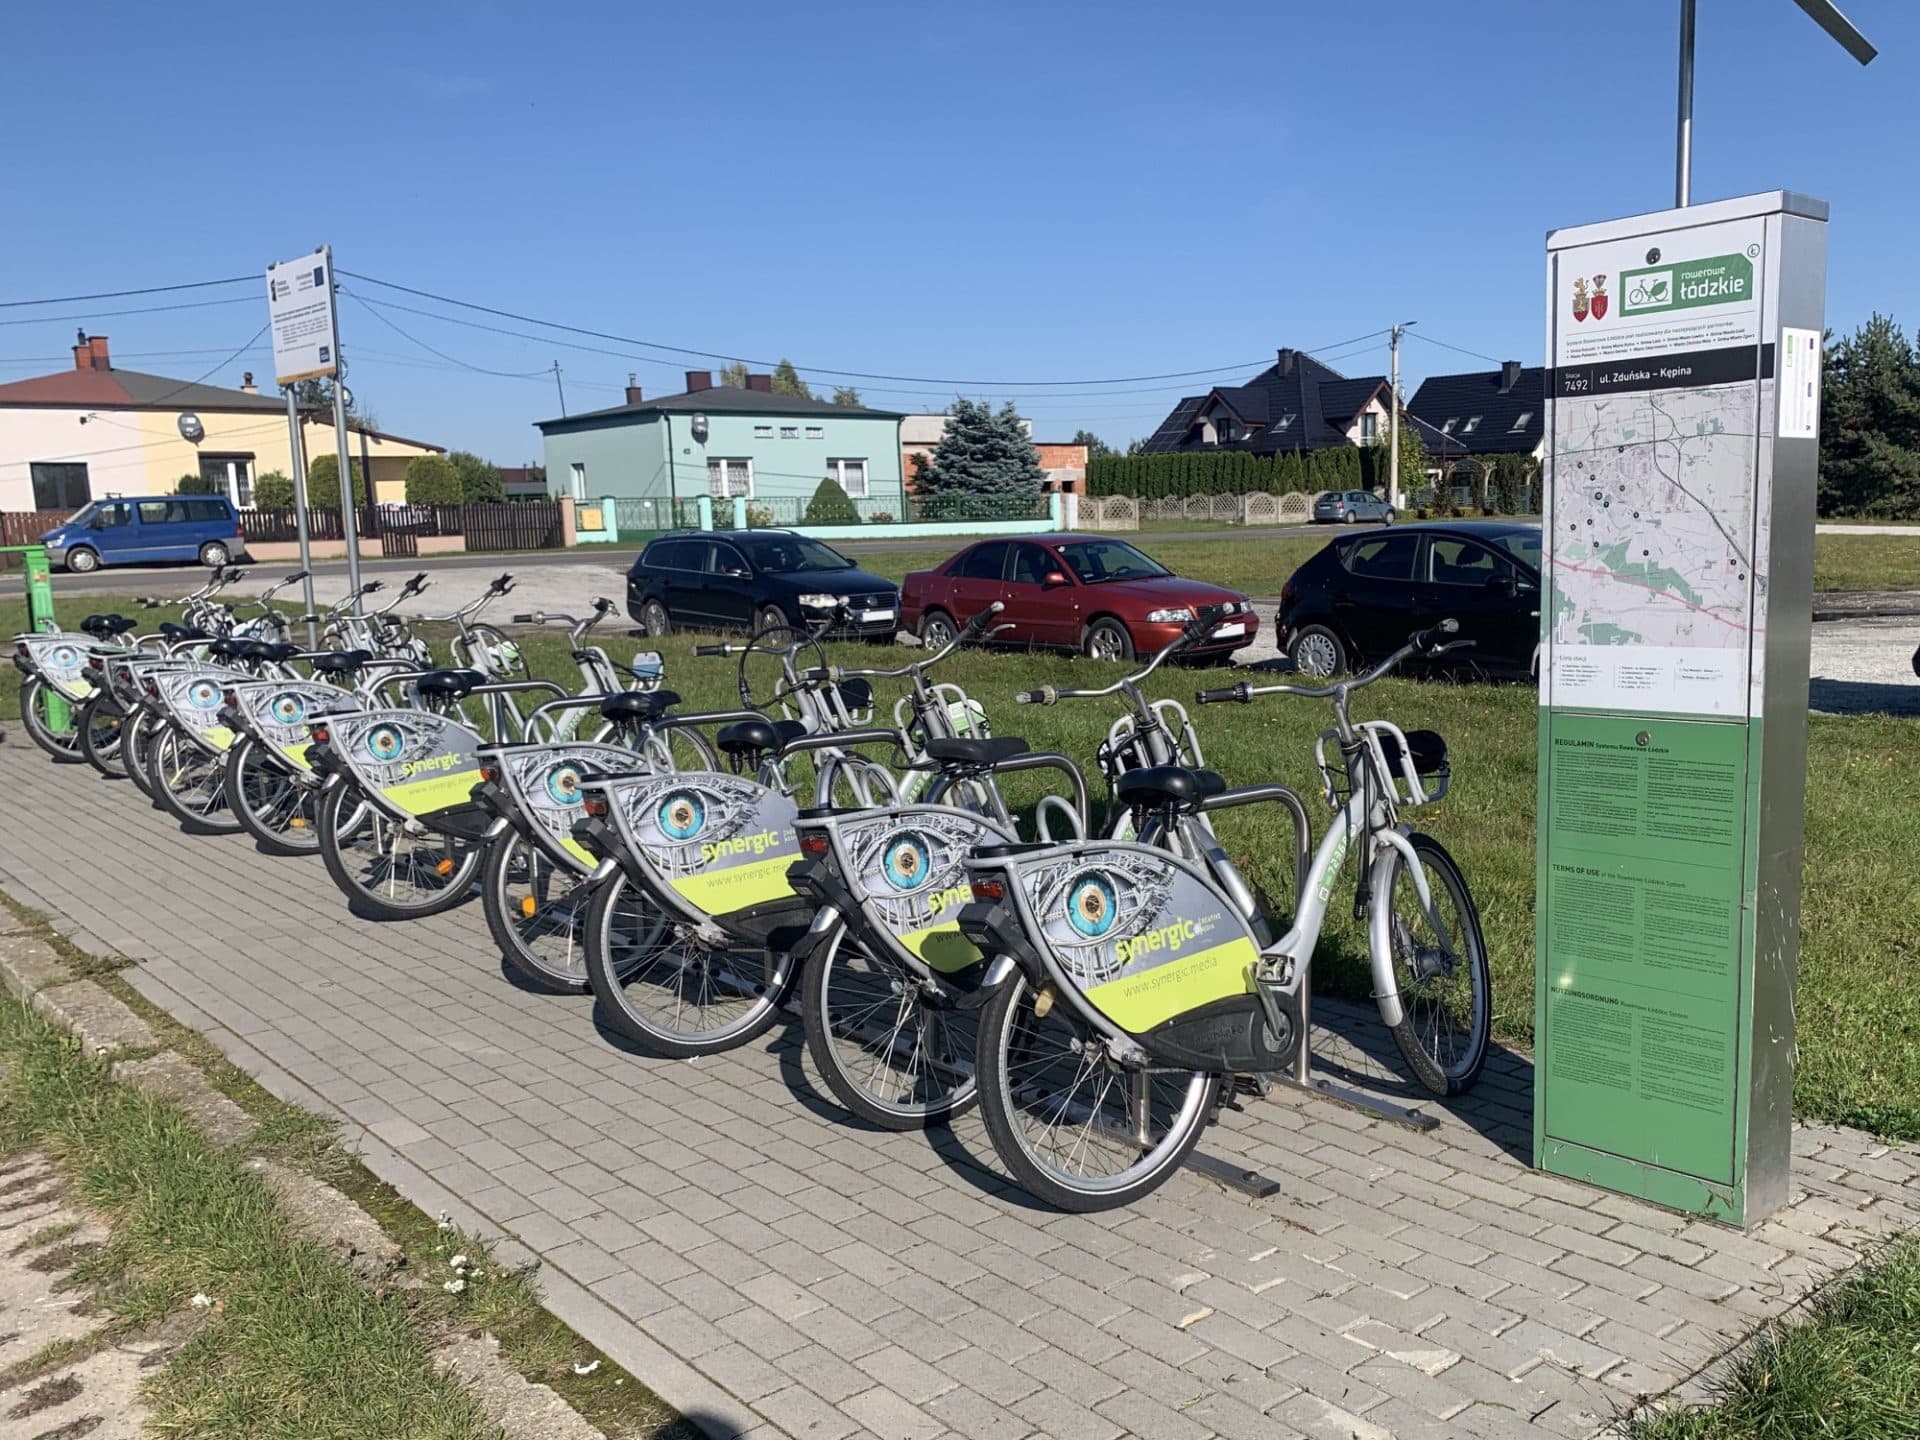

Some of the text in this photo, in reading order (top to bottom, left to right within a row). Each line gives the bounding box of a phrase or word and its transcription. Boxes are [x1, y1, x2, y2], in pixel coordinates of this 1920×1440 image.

[1681, 267, 1726, 280] rowerowe
[1565, 379, 1588, 392] 7492
[1599, 374, 1611, 384] ul.
[1612, 370, 1650, 383] Zduńska
[1660, 366, 1692, 380] Kępina
[1554, 738, 1594, 748] REGULAMIN
[401, 752, 462, 777] synergic
[701, 828, 779, 863] synergic
[706, 861, 789, 888] www.synergic.me
[1552, 863, 1575, 873] TERMS
[1586, 868, 1600, 877] USE
[928, 884, 971, 915] syne
[1114, 916, 1195, 966] synergic
[1123, 957, 1217, 998] www.synergic.media
[1550, 986, 1619, 1005] NUTZUNGSORDNUNG
